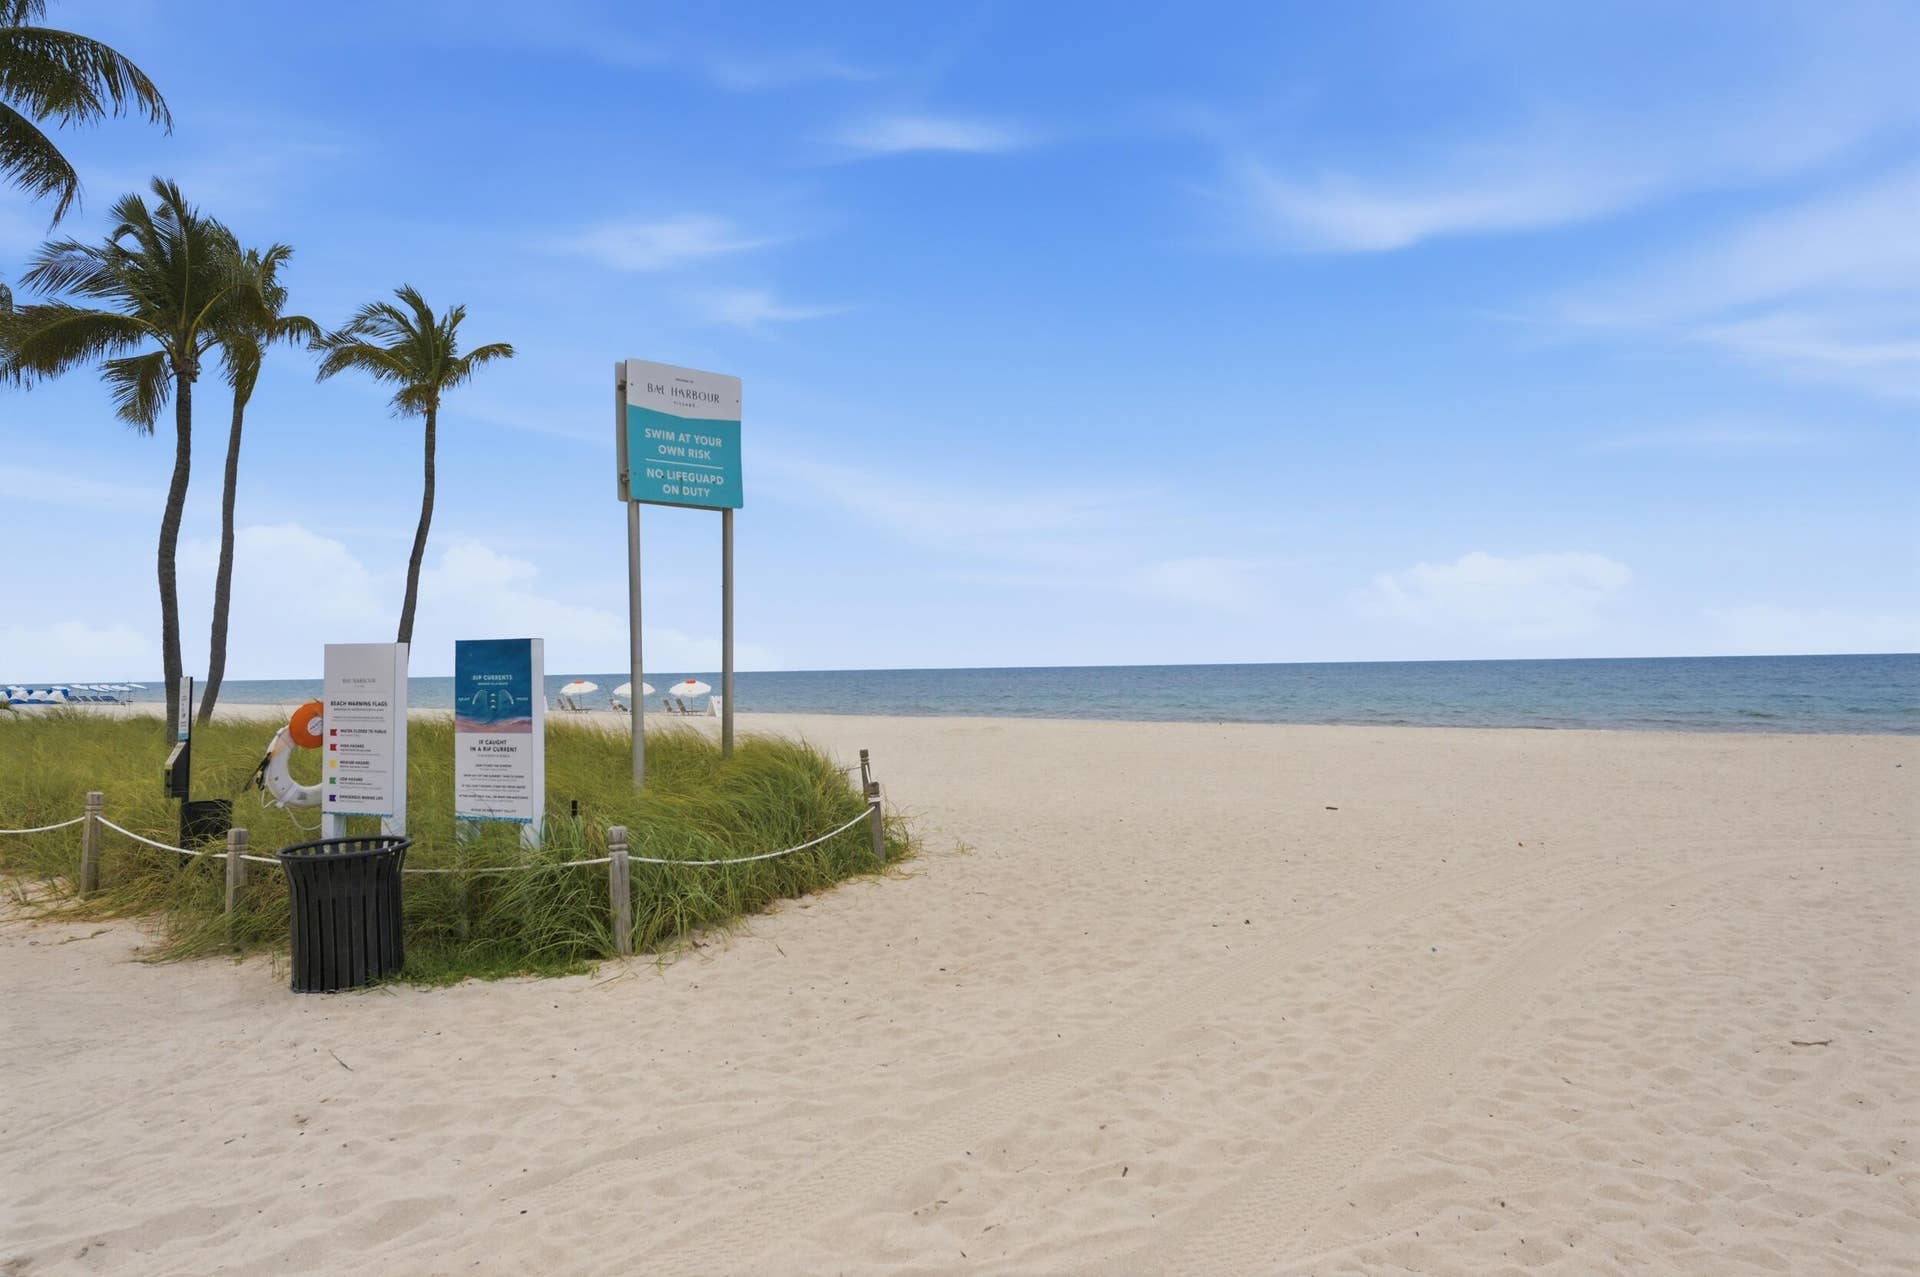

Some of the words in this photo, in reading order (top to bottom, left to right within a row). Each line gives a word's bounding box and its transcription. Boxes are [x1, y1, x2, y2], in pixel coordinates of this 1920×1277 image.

[647, 382, 664, 395] BAL
[671, 387, 720, 404] HARBOUR
[645, 428, 675, 442] SWIM
[678, 433, 691, 443] AT
[694, 435, 722, 447] YOUR
[658, 445, 685, 456] OWN
[688, 448, 711, 460] RISK
[646, 468, 664, 478] NO
[666, 470, 724, 485] LIFEGUARD
[662, 484, 679, 495] ON
[682, 486, 710, 497] DUTY
